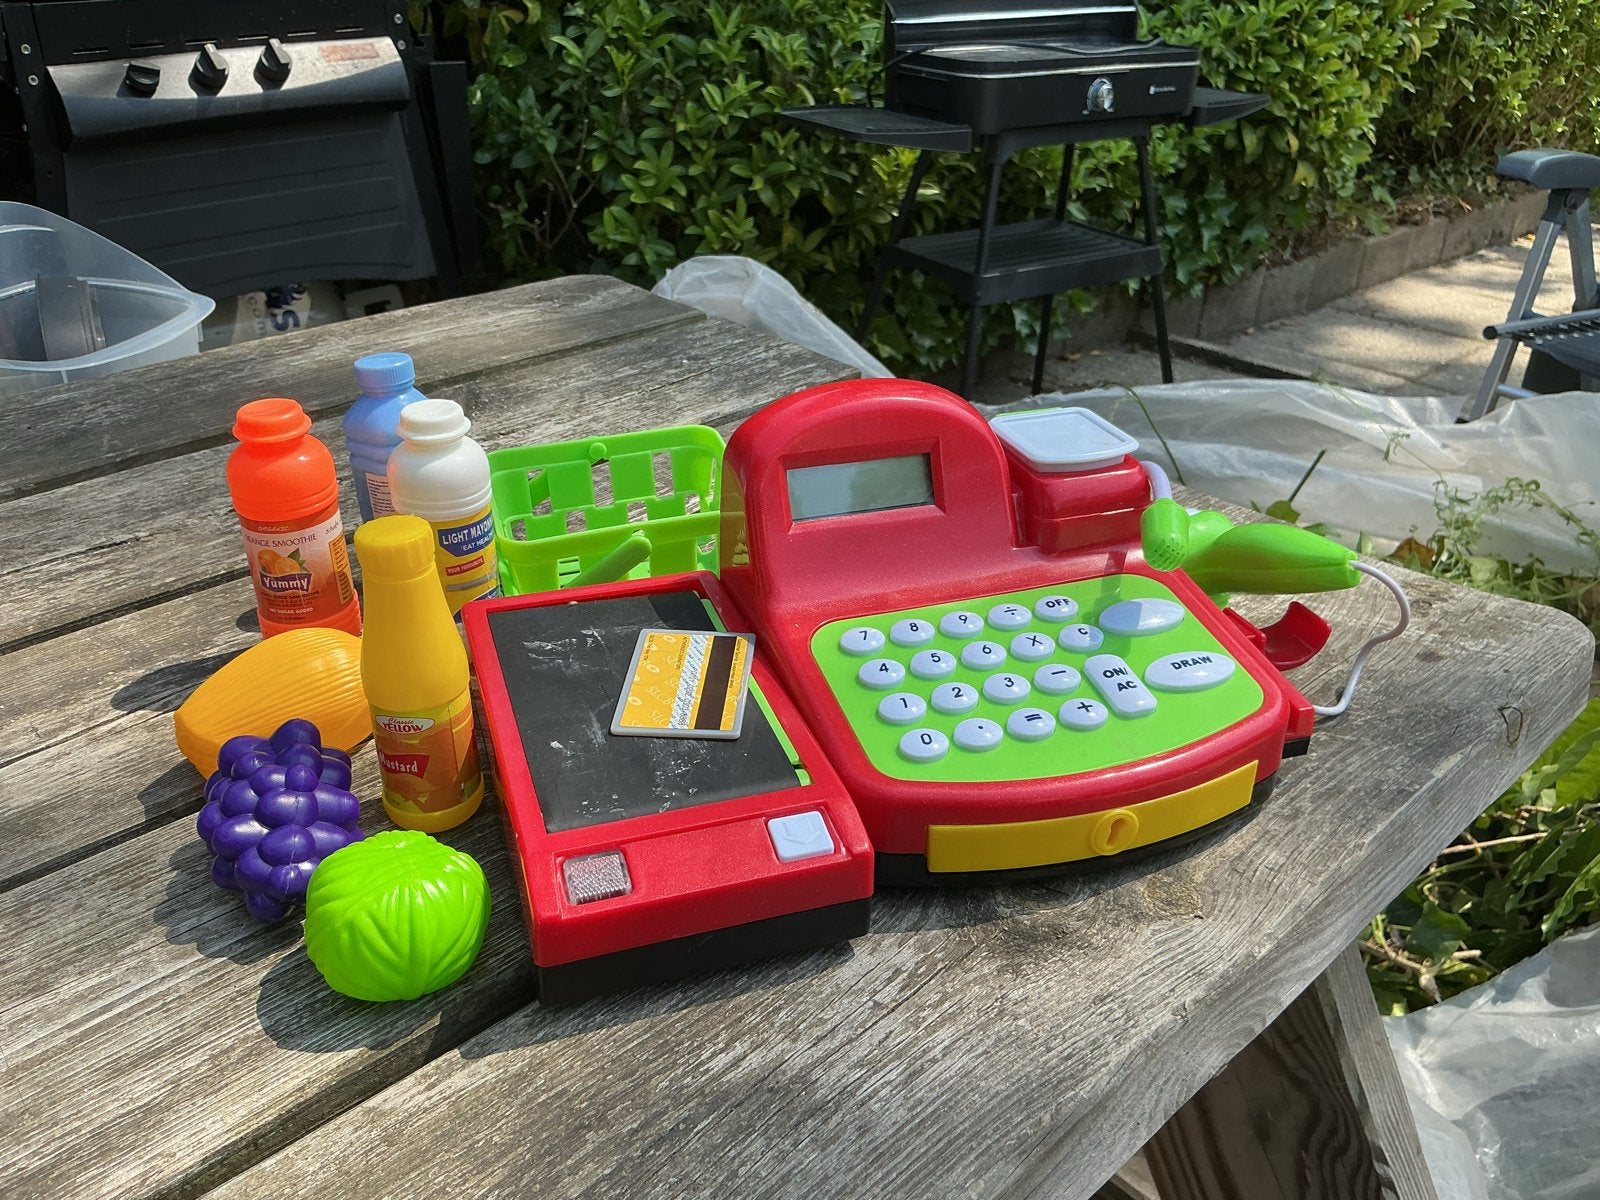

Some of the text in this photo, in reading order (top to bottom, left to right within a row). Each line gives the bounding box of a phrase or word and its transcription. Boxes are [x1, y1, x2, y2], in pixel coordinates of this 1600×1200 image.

[272, 533, 318, 548] SMOOTHIE
[442, 528, 470, 545] LIGHT
[263, 576, 308, 590] Yummy
[1045, 598, 1072, 609] OFF
[958, 614, 968, 624] 9
[909, 622, 919, 632] 8
[859, 630, 868, 641] 7
[982, 644, 992, 655] 6
[930, 653, 941, 663] 5
[1169, 655, 1213, 671] DRAW
[879, 662, 890, 673] 4
[1102, 666, 1129, 679] ON/
[1004, 676, 1015, 688] 3
[1116, 680, 1138, 692] AC
[951, 686, 963, 698] 2
[899, 697, 908, 709] 1
[388, 717, 415, 725] Classic
[382, 722, 424, 733] YELLOW
[920, 733, 933, 745] 0
[379, 751, 418, 773] Mustard
